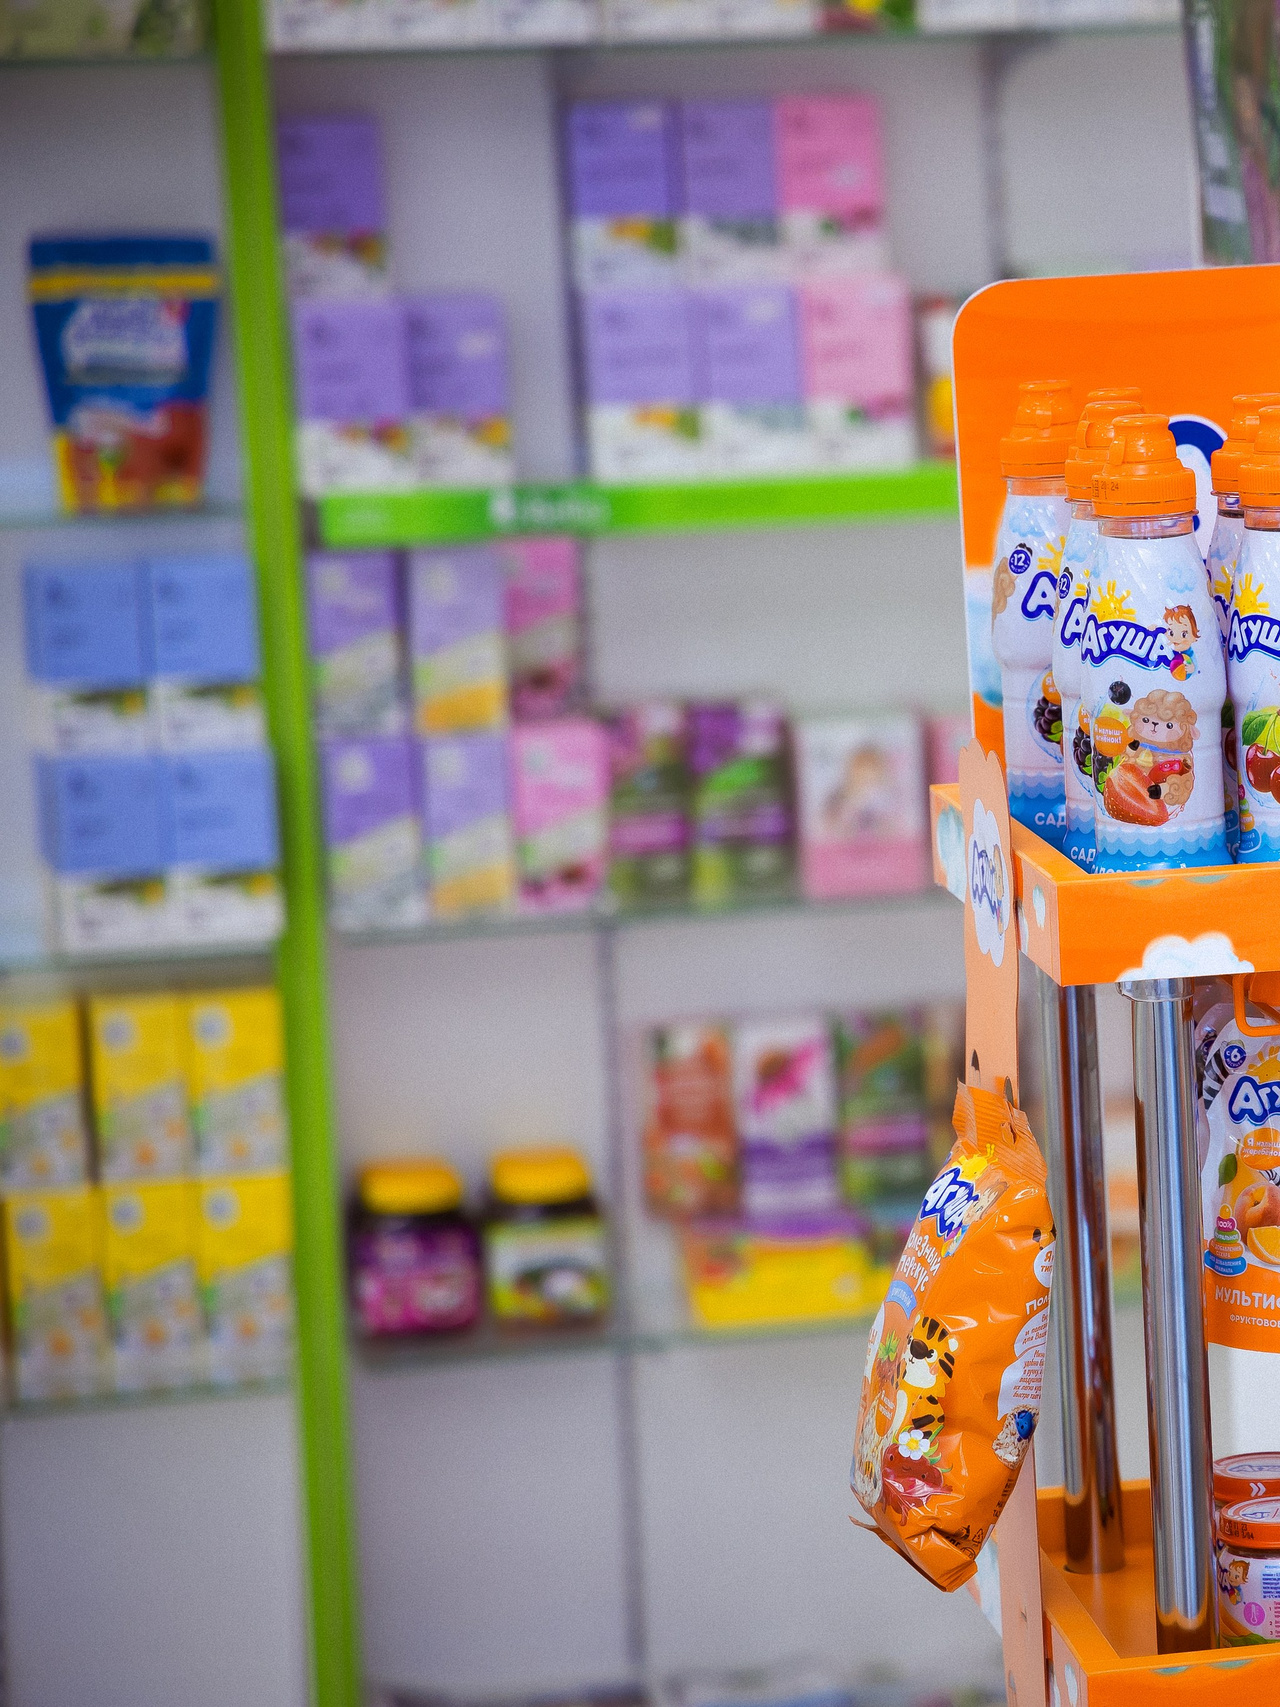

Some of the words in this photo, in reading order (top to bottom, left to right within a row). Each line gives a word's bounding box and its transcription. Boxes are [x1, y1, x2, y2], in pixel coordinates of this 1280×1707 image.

[1013, 553, 1026, 566] 12
[1035, 812, 1067, 828] САД
[1070, 847, 1096, 864] САД
[1231, 1048, 1240, 1060] 6
[1247, 1139, 1254, 1147] Я
[1044, 1251, 1052, 1262] Я
[1026, 1295, 1050, 1315] Пол
